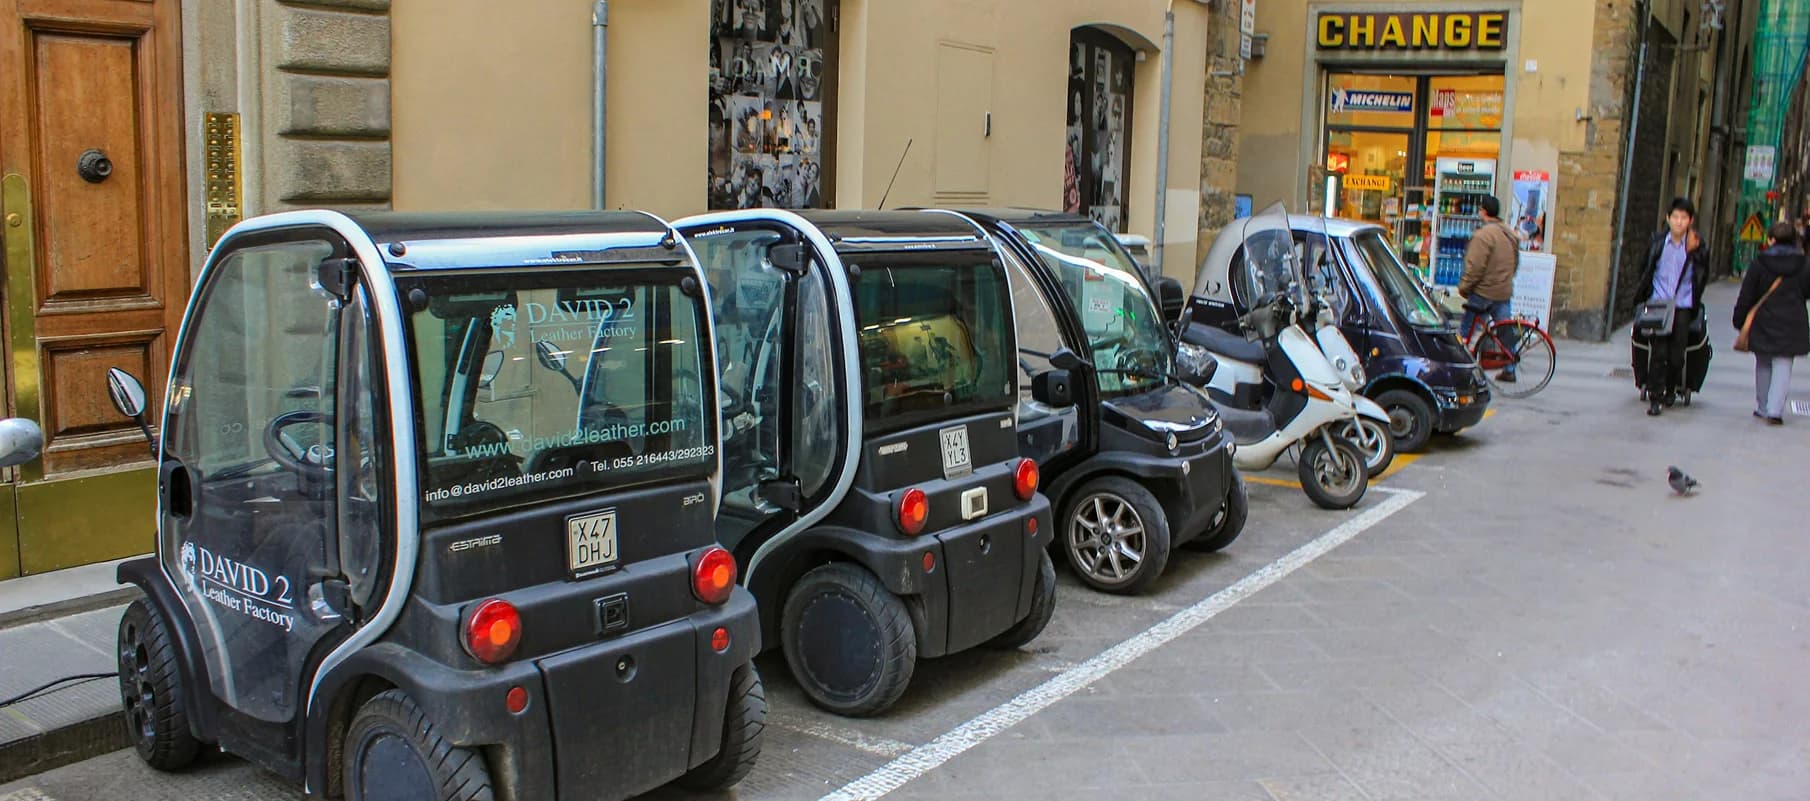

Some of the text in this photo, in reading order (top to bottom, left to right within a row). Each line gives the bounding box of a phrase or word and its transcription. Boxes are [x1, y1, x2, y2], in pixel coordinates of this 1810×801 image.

[1318, 14, 1504, 47] CHANGE
[1350, 93, 1411, 107] MICHELIN
[526, 298, 635, 324] DAVID 2
[531, 322, 637, 343] Leather Factory
[945, 431, 964, 448] X4Y
[591, 459, 611, 472] Tel.
[613, 456, 634, 470] 055
[636, 444, 715, 466] 216443/292323
[947, 447, 966, 465] YL3
[577, 517, 611, 541] X47
[579, 538, 613, 564] DHJ
[200, 547, 293, 604] DAVID 2
[201, 580, 294, 632] Leather Factory
